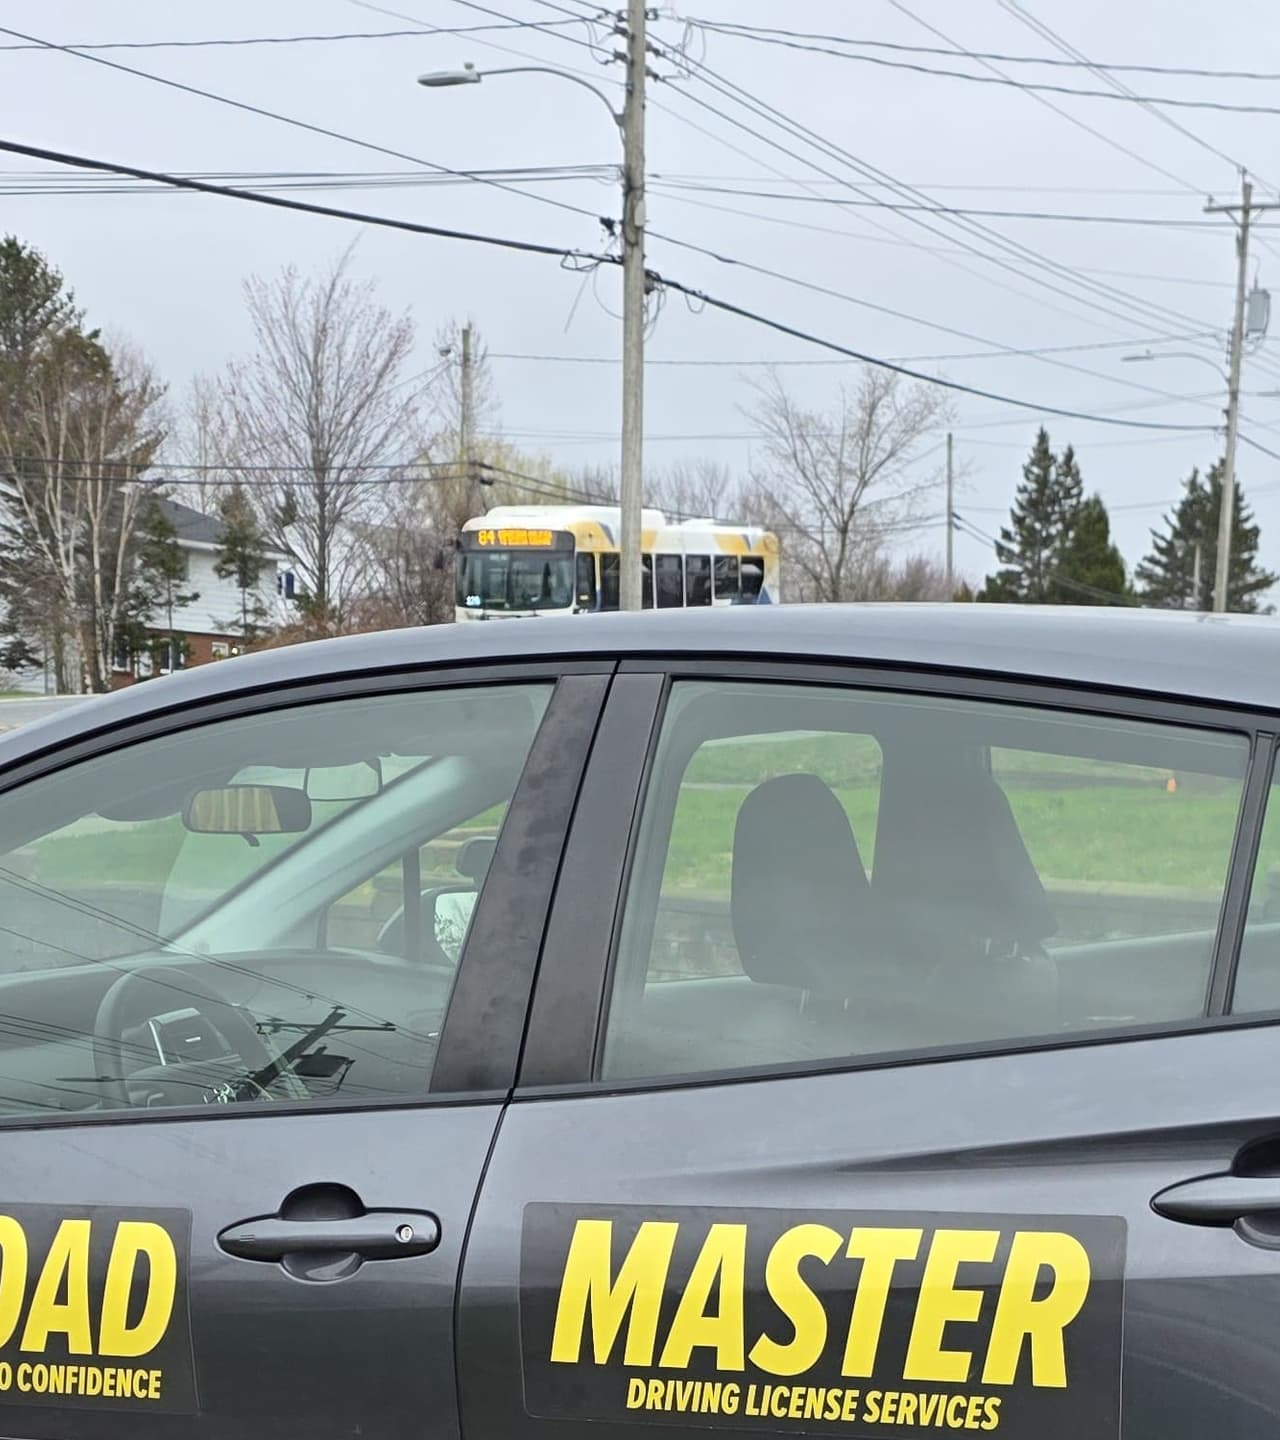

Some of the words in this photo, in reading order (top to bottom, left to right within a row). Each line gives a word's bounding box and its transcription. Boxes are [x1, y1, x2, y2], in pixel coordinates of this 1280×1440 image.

[550, 1219, 1091, 1388] MASTER
[17, 1363, 162, 1399] CONFIDENCE
[626, 1378, 741, 1415] DRIVING
[745, 1384, 858, 1422] LICENSE
[862, 1390, 1003, 1431] SERVICES
